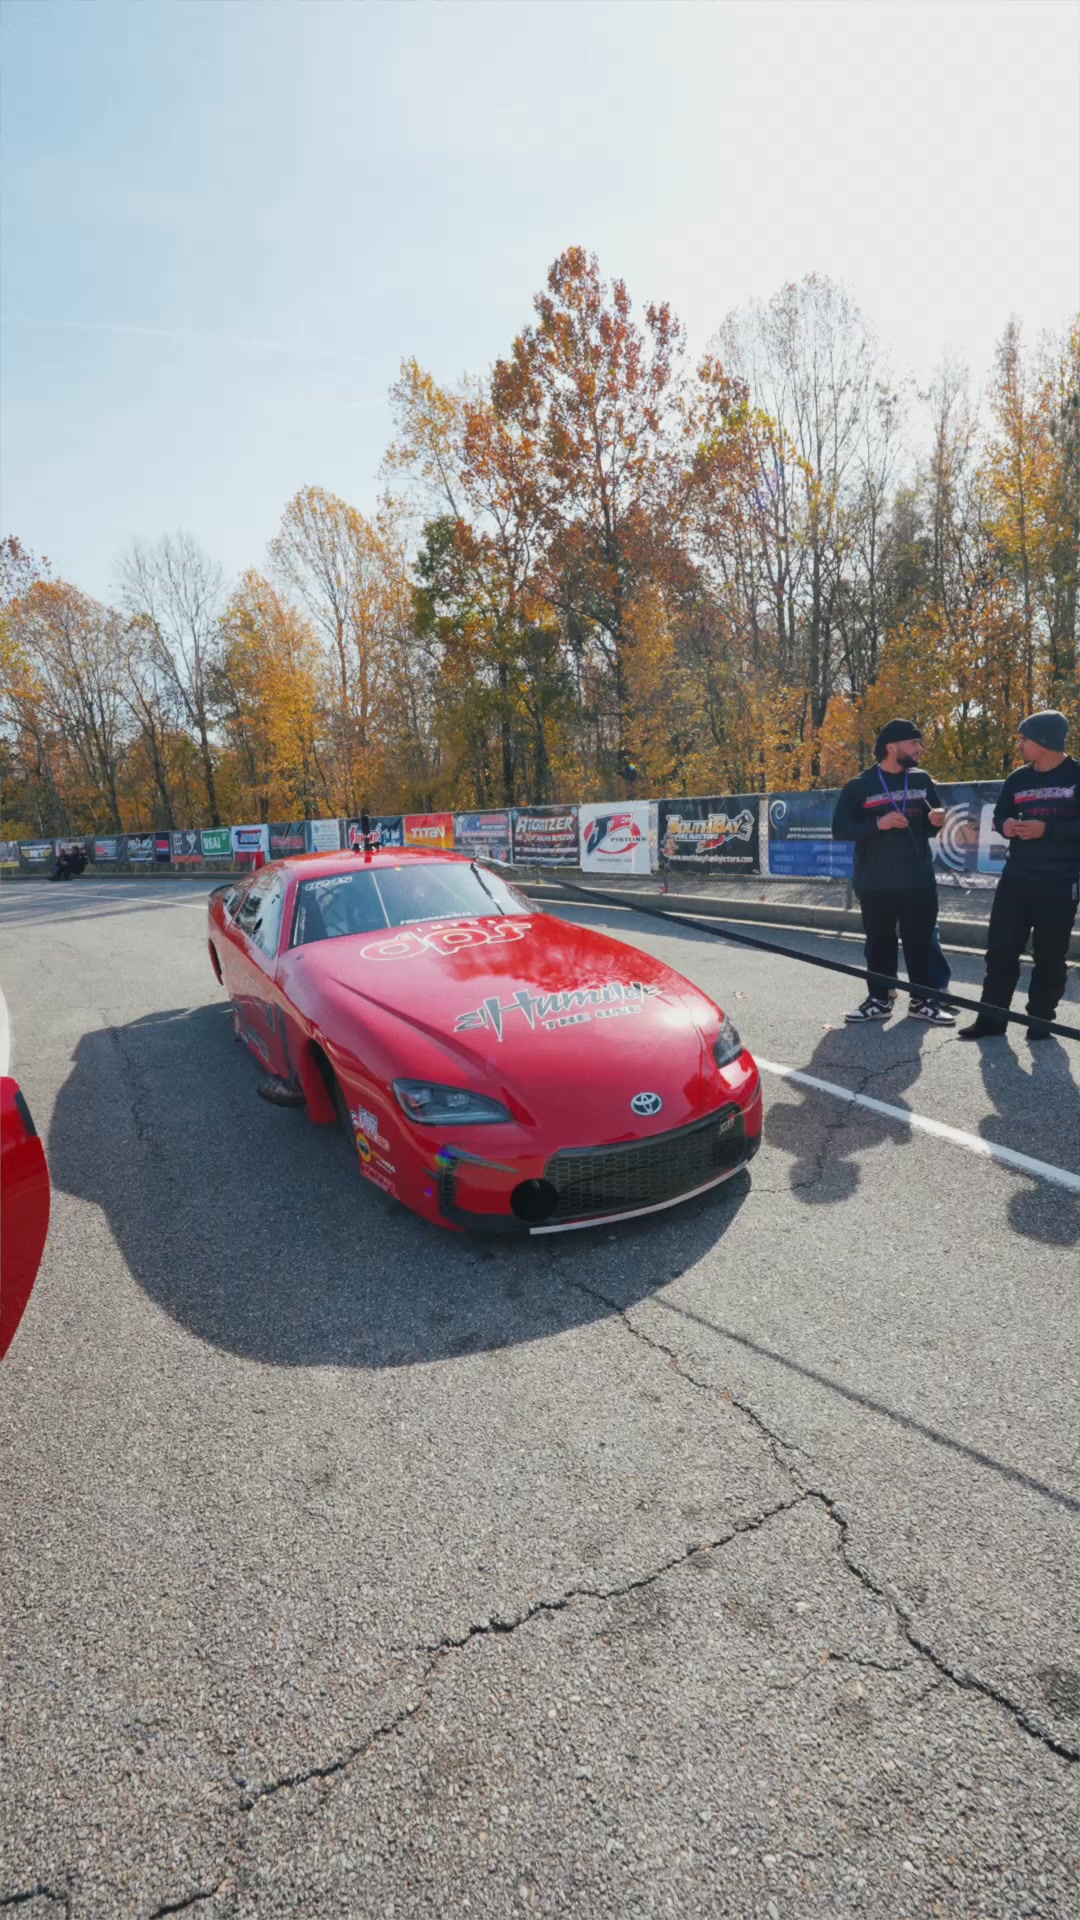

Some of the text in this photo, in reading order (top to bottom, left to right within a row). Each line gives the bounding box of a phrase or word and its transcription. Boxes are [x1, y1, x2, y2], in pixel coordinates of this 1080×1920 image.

[410, 826, 446, 839] TITAN
[515, 816, 573, 833] ATOMIZER
[541, 1004, 643, 1031] THE ONE
